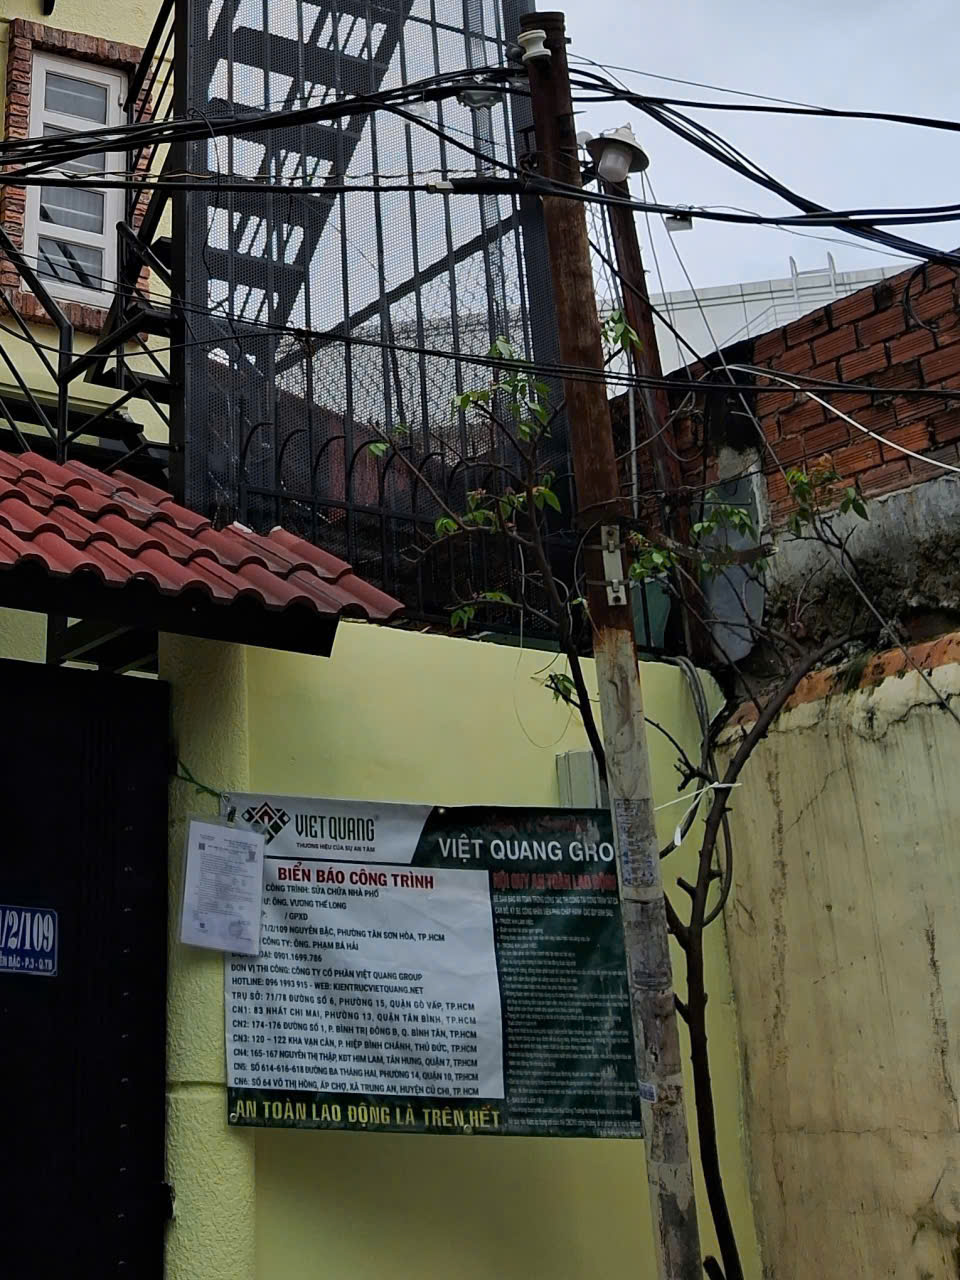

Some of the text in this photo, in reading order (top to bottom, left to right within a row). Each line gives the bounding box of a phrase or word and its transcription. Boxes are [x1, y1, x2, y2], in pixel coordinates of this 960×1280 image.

[439, 834, 483, 862] VIỆT
[491, 839, 562, 860] QUANG
[278, 862, 433, 888] BIỂN BÁO CÔNG TRÌNH
[266, 884, 285, 892] CÔNG
[288, 884, 309, 893] TRÌNH:
[364, 889, 379, 897] PHỐ
[315, 899, 328, 908] THẾ
[262, 936, 280, 945] CÔNG
[313, 941, 333, 950] PHẠM
[384, 931, 397, 939] SƠN
[418, 933, 445, 941] TP.HCM
[274, 951, 322, 962] 0901.1699.786
[248, 965, 255, 973] VỊ
[292, 966, 310, 975] CÔNG
[356, 969, 371, 980] VIỆT
[373, 972, 397, 980] QUANG
[399, 973, 423, 981] GROUP
[266, 978, 278, 986] 096
[315, 982, 332, 990] WEB:
[334, 983, 424, 994] KIENTRUCVIETQUANG.NET
[232, 992, 247, 1001] TRỤ
[266, 993, 286, 1001] 71/78
[317, 996, 327, 1004] SỐ
[376, 1000, 387, 1008] 15,
[390, 999, 411, 1009] QUẬN
[446, 1002, 474, 1010] TP.HCM
[232, 1006, 251, 1014] CN1:
[290, 1008, 303, 1016] CHI
[306, 1010, 322, 1019] MAI,
[377, 1014, 399, 1023] QUẬN
[403, 1014, 418, 1022] TÂN
[446, 1016, 476, 1024] TP.HCM
[252, 1021, 281, 1029] 174-176
[310, 1022, 318, 1031] SỐ
[336, 1024, 354, 1033] BÌNH
[356, 1026, 367, 1036] TRỊ
[392, 1028, 399, 1037] B,
[402, 1029, 409, 1037] Q.
[411, 1028, 429, 1036] BÌNH
[432, 1029, 448, 1039] TÂN,
[450, 1030, 476, 1038] TP.HCM
[233, 1034, 249, 1042] CN3:
[274, 1036, 286, 1044] 122
[304, 1039, 318, 1047] VẠN
[346, 1040, 362, 1050] HIỆP
[365, 1040, 382, 1049] BÌNH
[415, 1041, 430, 1051] THỦ
[251, 1050, 277, 1058] 165-167
[308, 1052, 317, 1060] THỊ
[353, 1055, 366, 1063] HIM
[368, 1055, 384, 1064] LAM,
[386, 1056, 400, 1064] TÂN
[425, 1056, 445, 1067] QUẬN
[261, 1064, 304, 1073] 614-616-618
[340, 1068, 363, 1077] THÁNG
[412, 1072, 421, 1080] 14,
[423, 1071, 442, 1081] QUẬN
[444, 1073, 453, 1081] 10,
[455, 1073, 478, 1081] TP.HCM
[234, 1077, 249, 1085] CN6:
[252, 1077, 261, 1086] SỐ
[285, 1080, 297, 1088] THỊ
[360, 1084, 384, 1092] TRUNG
[386, 1085, 398, 1094] AN,
[400, 1086, 424, 1095] HUYỆN
[236, 1100, 256, 1117] AN
[263, 1098, 306, 1120] TOÀN
[313, 1104, 341, 1121] LAO
[348, 1102, 390, 1127] ĐỘNG
[396, 1103, 415, 1125] LÀ
[423, 1106, 464, 1127] TRÊN
[470, 1105, 500, 1128] HẾT
